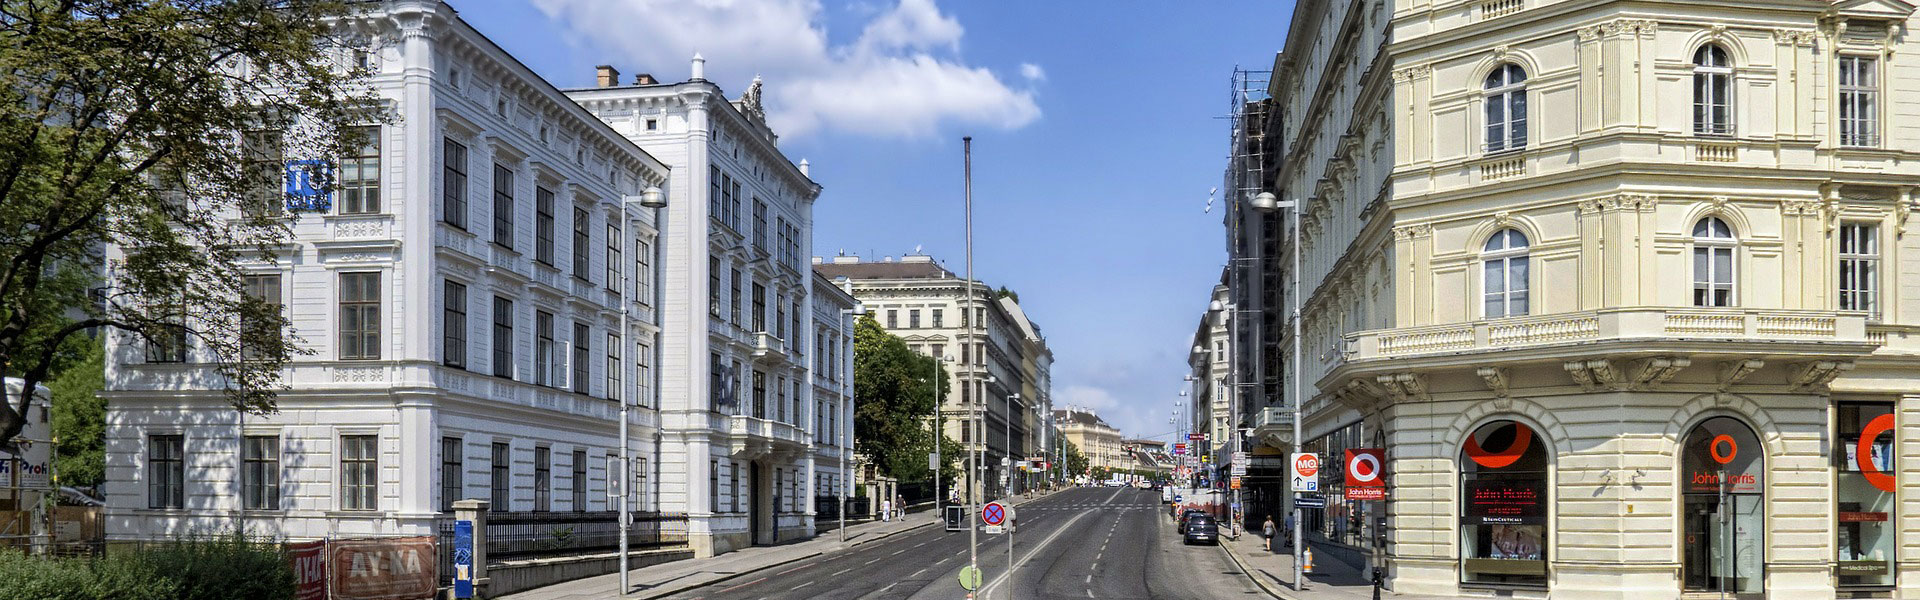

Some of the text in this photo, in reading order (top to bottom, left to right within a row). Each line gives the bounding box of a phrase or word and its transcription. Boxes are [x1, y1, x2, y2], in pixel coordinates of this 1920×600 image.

[1297, 459, 1317, 468] MQ
[1692, 471, 1718, 484] John
[1475, 488, 1500, 498] John
[350, 549, 421, 577] AY-KA
